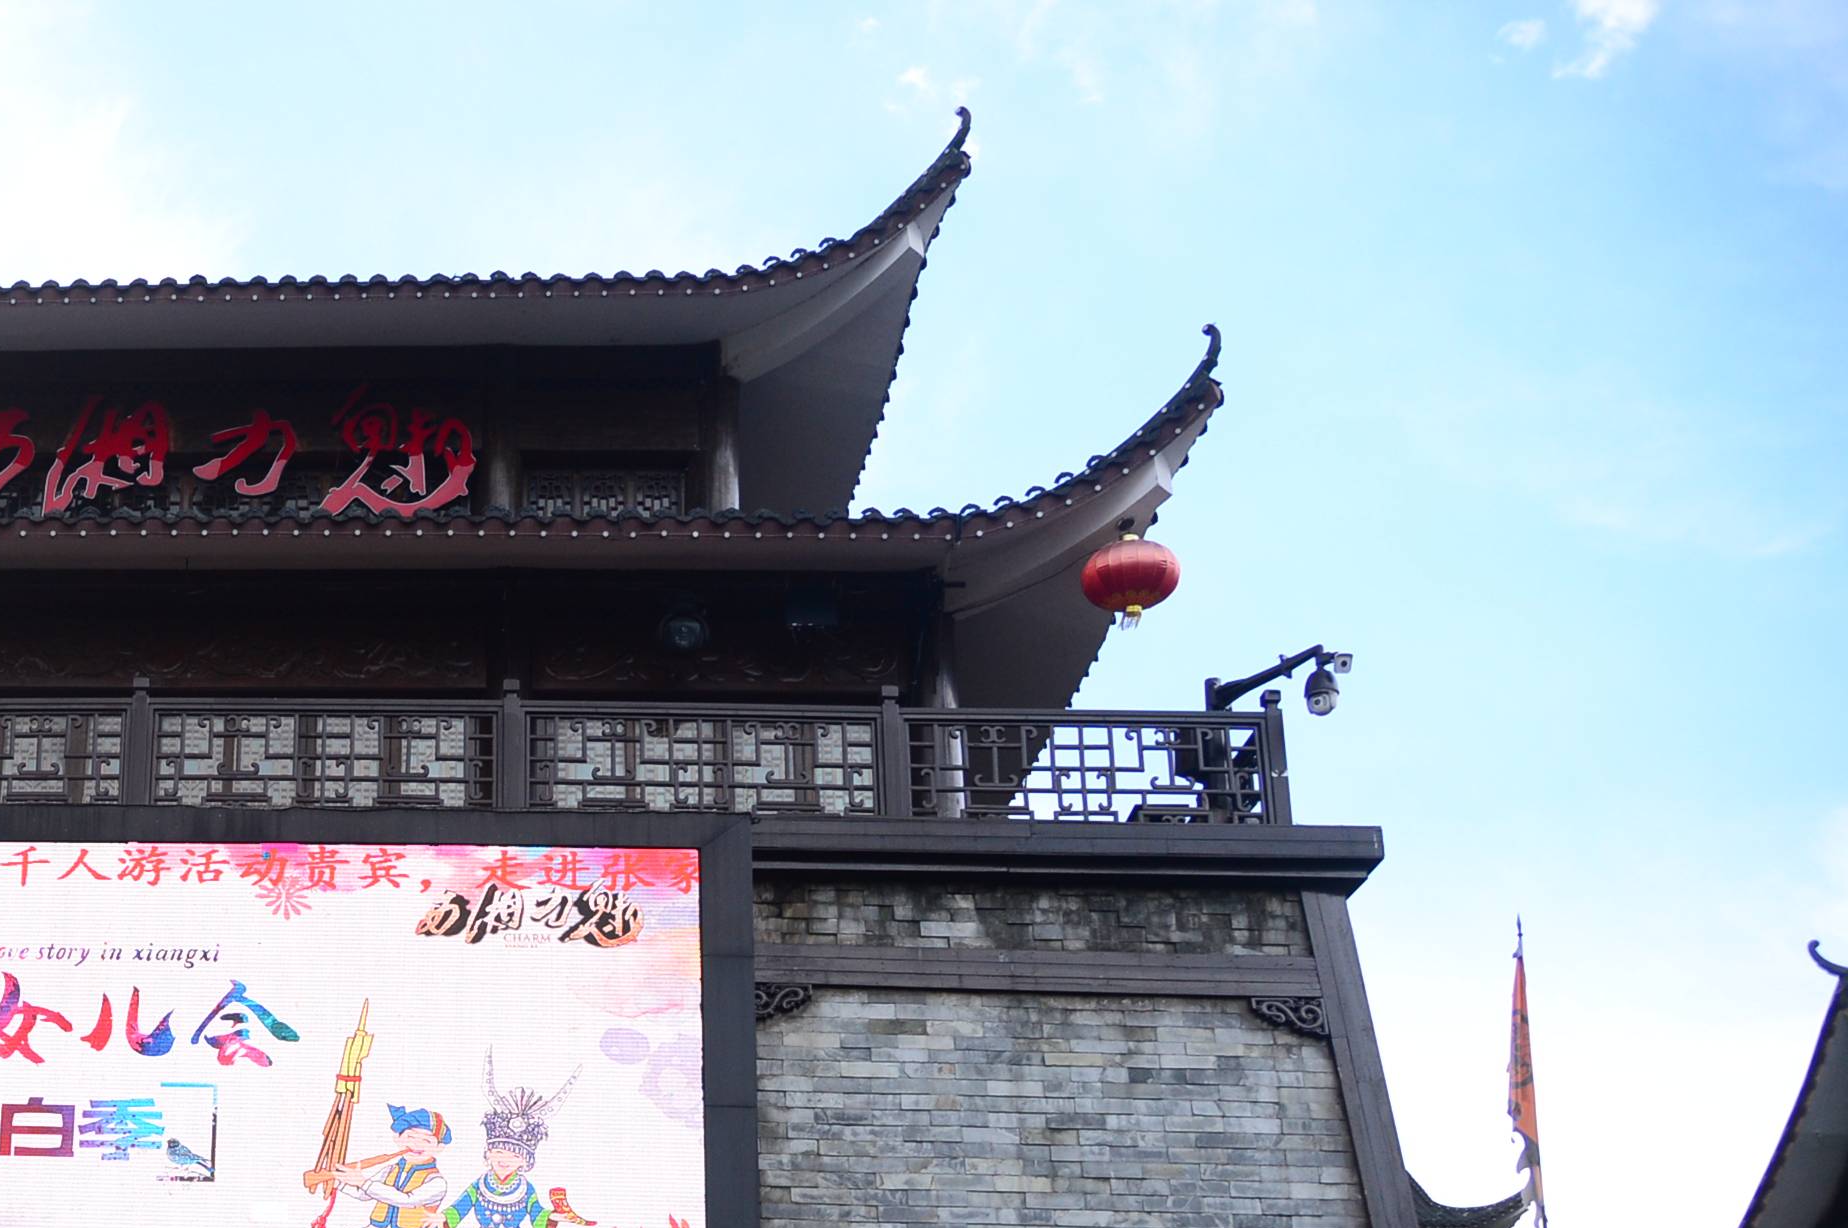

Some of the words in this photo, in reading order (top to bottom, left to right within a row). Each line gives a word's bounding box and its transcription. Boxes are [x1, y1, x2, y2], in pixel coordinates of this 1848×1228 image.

[36, 943, 90, 967] story
[101, 942, 122, 961] in
[132, 942, 220, 969] xiangxi
